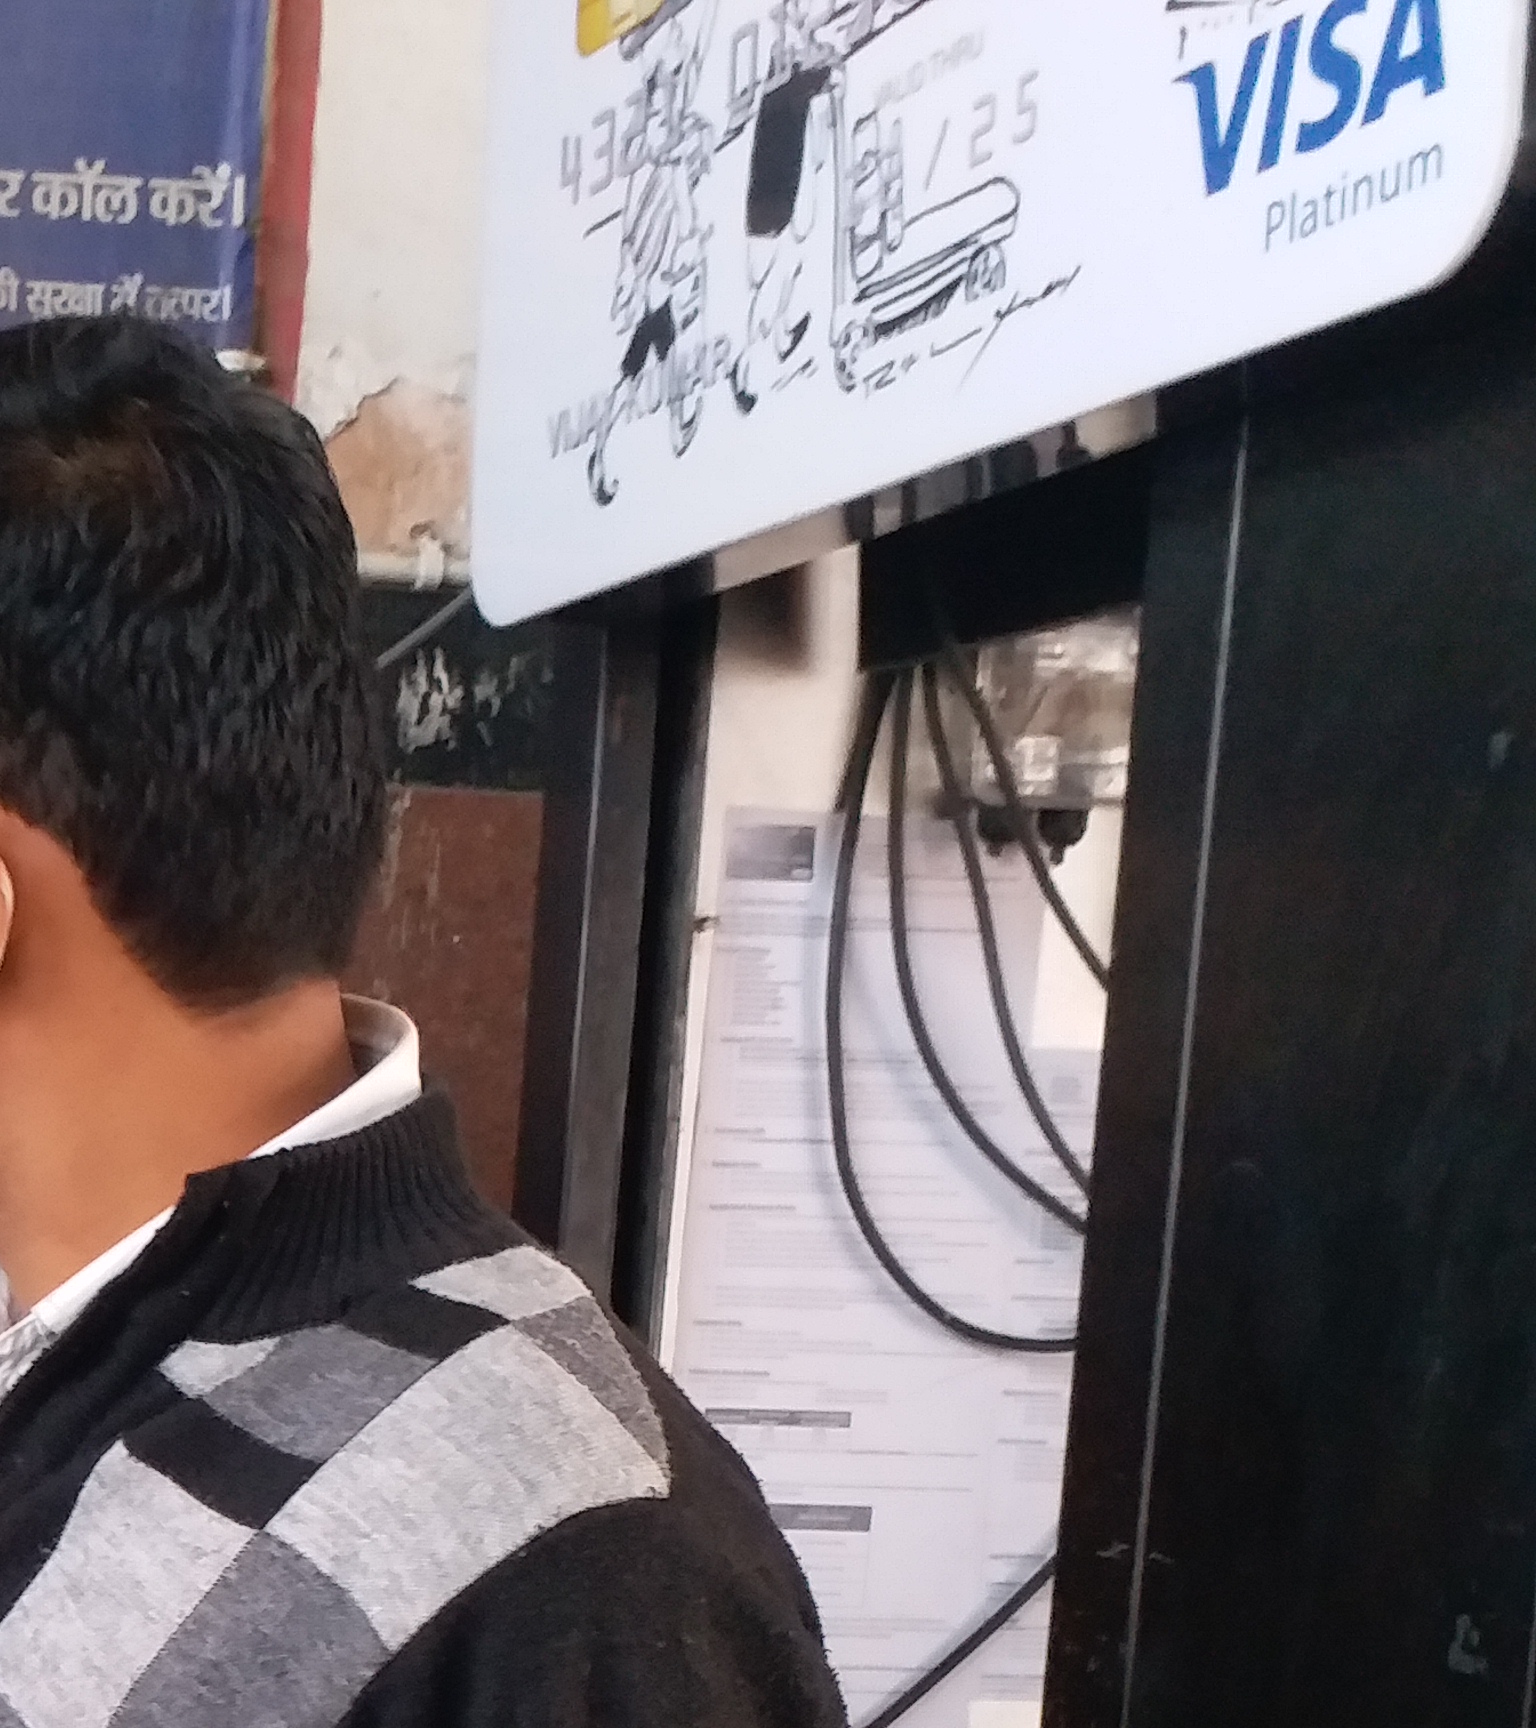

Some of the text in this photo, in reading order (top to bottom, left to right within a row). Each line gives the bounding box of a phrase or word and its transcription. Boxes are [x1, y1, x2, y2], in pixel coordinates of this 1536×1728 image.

[1172, 0, 1445, 197] VISA
[31, 157, 143, 224] कॉल
[1265, 143, 1443, 252] Platinum
